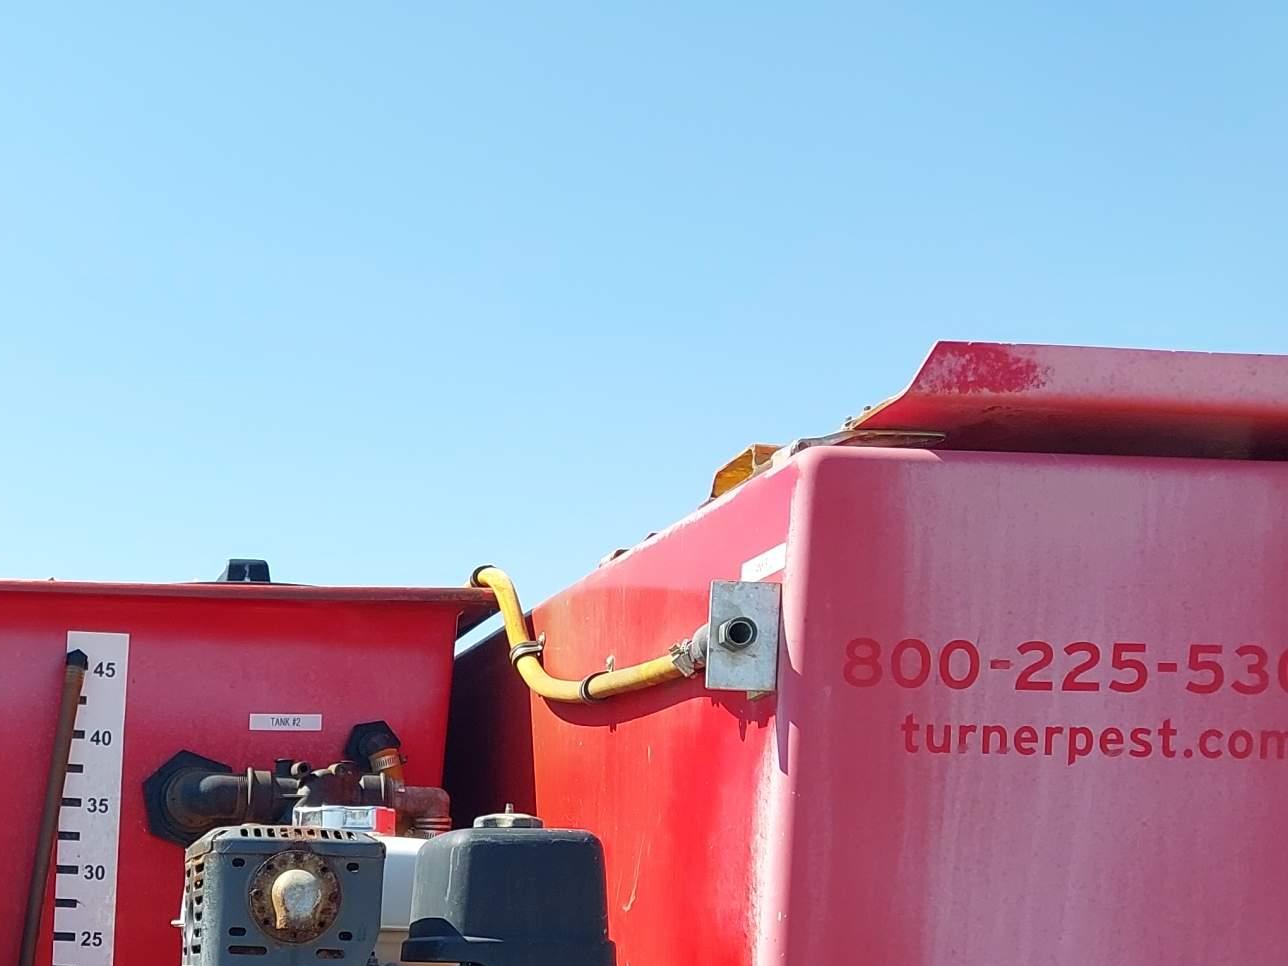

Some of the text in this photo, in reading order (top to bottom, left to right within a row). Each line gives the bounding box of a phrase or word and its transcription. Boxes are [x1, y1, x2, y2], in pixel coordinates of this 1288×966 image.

[93, 662, 116, 678] 45
[842, 638, 1288, 696] 800-225-53
[270, 717, 301, 728] TANK #2
[90, 730, 112, 746] 40
[900, 712, 1288, 767] turnerpest.com
[87, 798, 109, 814] 35
[83, 864, 106, 880] 30
[80, 931, 103, 947] 25
